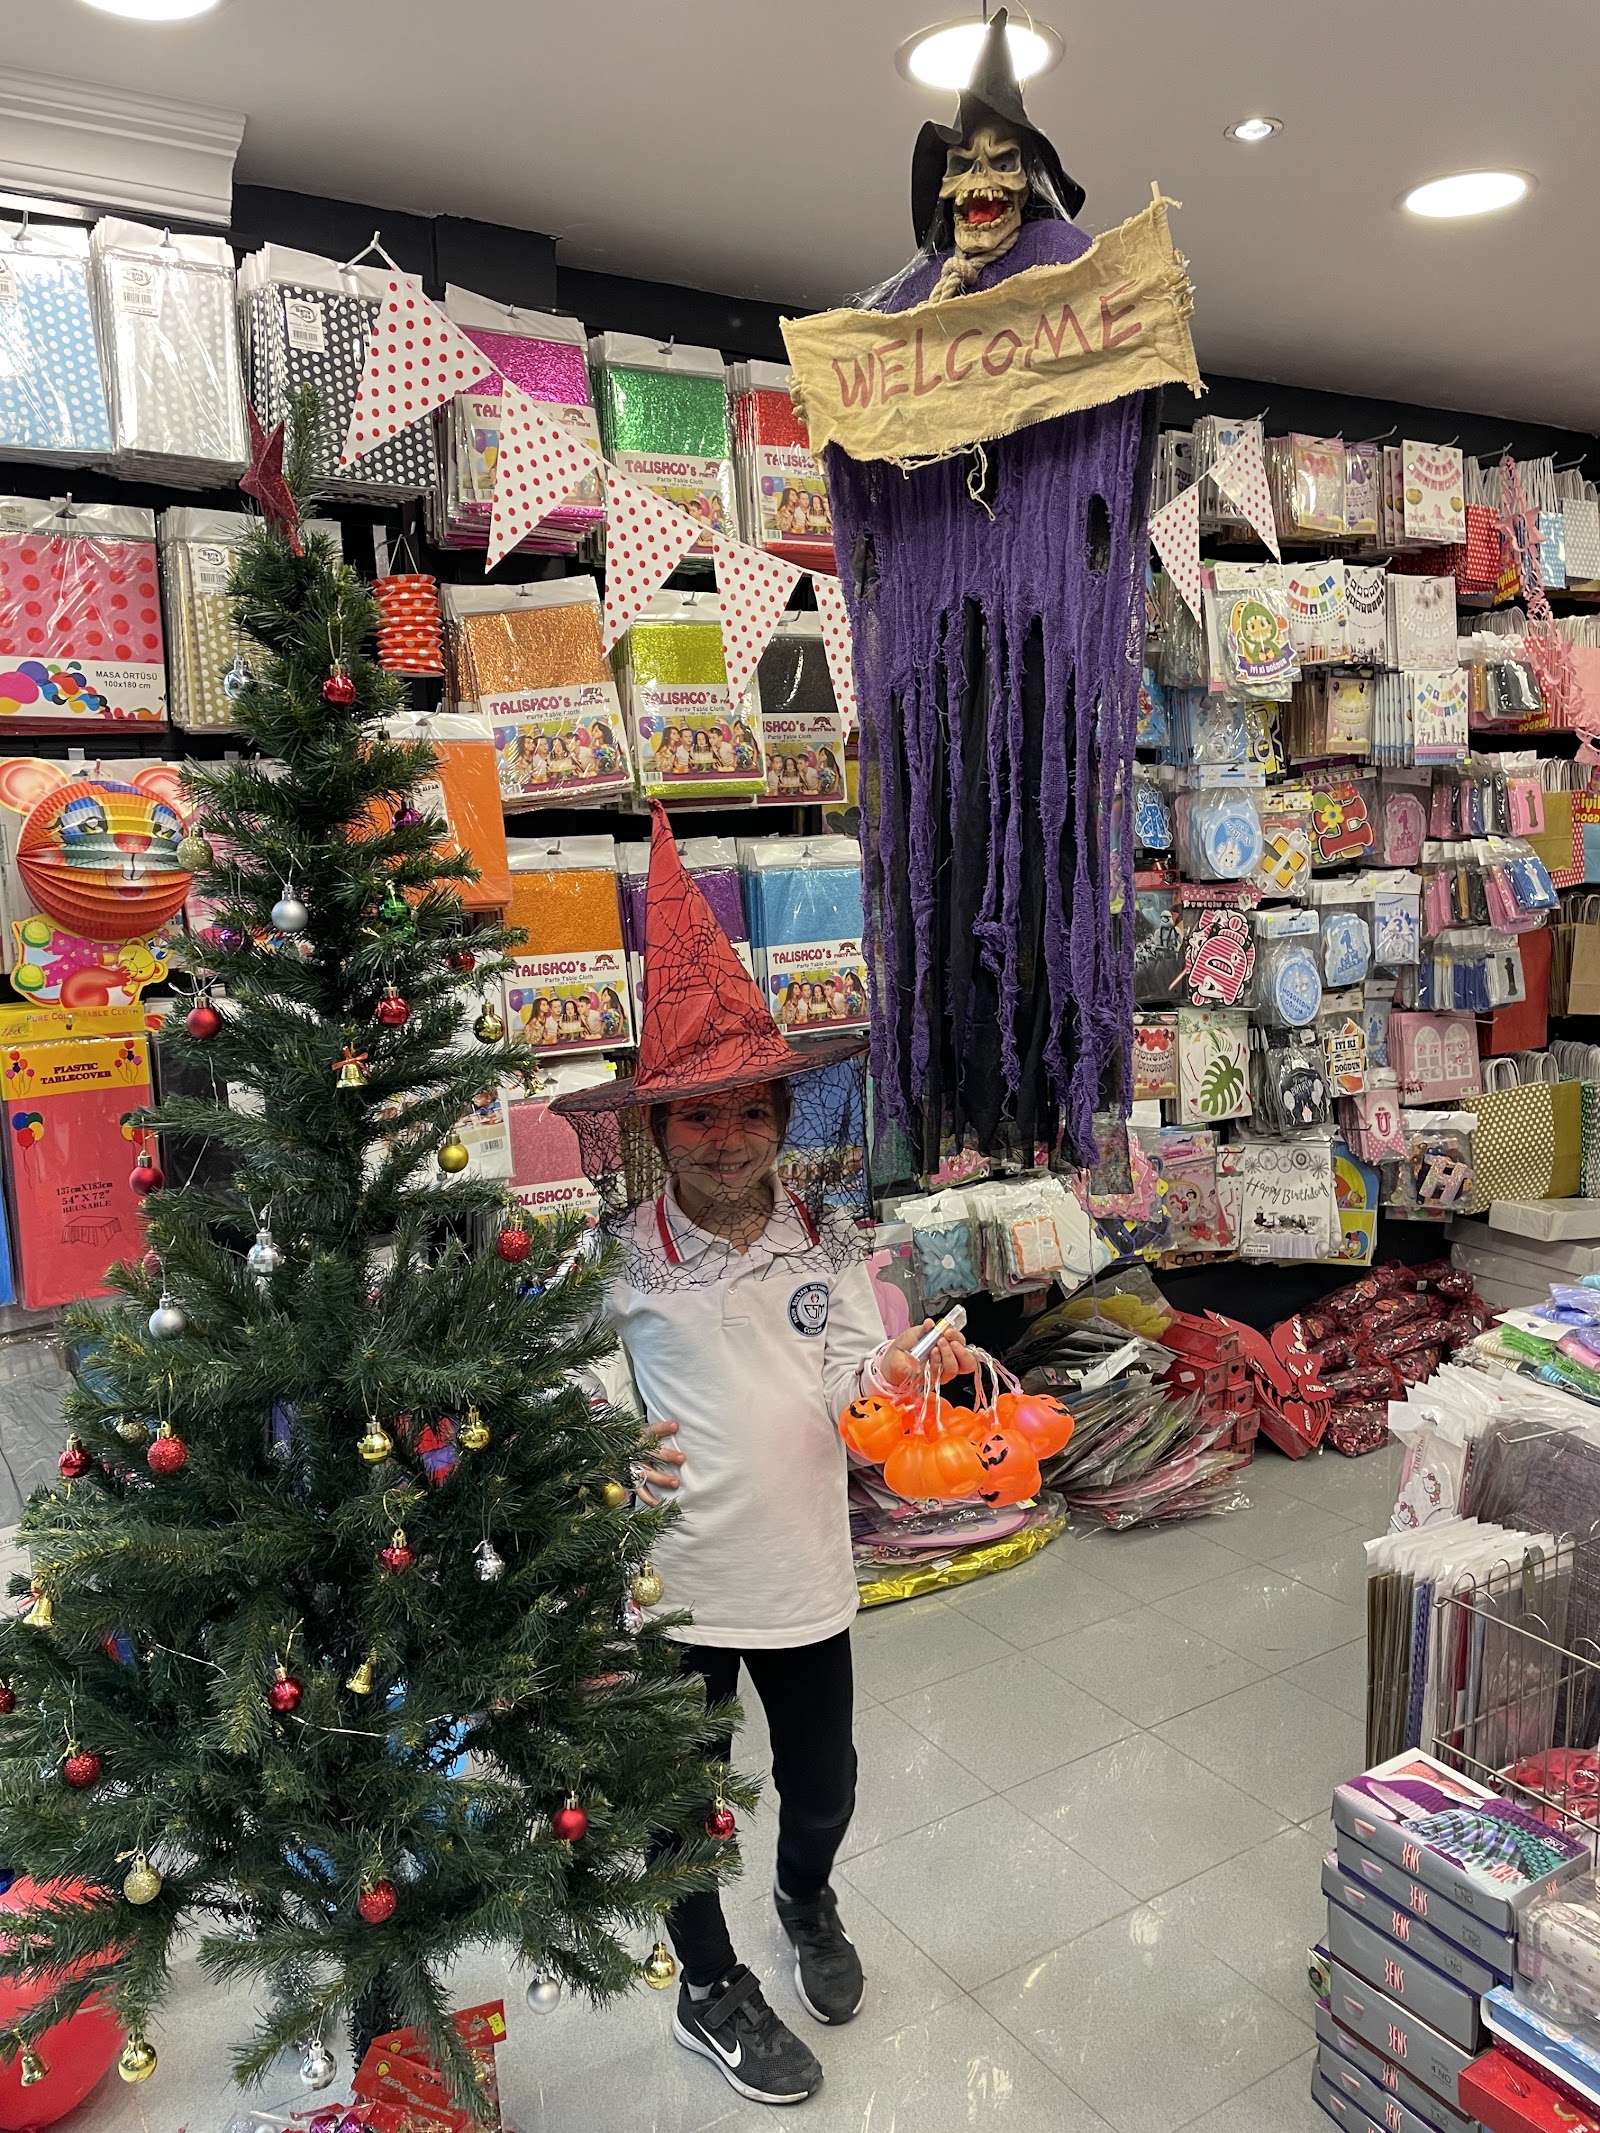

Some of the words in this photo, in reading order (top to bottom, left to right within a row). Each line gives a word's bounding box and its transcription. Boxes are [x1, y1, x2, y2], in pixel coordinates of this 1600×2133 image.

[832, 280, 1142, 408] WELCOME
[96, 671, 121, 679] MASA
[123, 670, 158, 680] ÖRTÜSÜ
[104, 680, 137, 688] 100x180
[27, 1014, 49, 1022] PURE
[54, 1063, 98, 1074] PLASTIC
[40, 1071, 112, 1085] TABLECOVER
[1246, 1177, 1282, 1205] Happy
[1282, 1181, 1330, 1205] Birthday
[62, 1201, 112, 1213] REUSABLE
